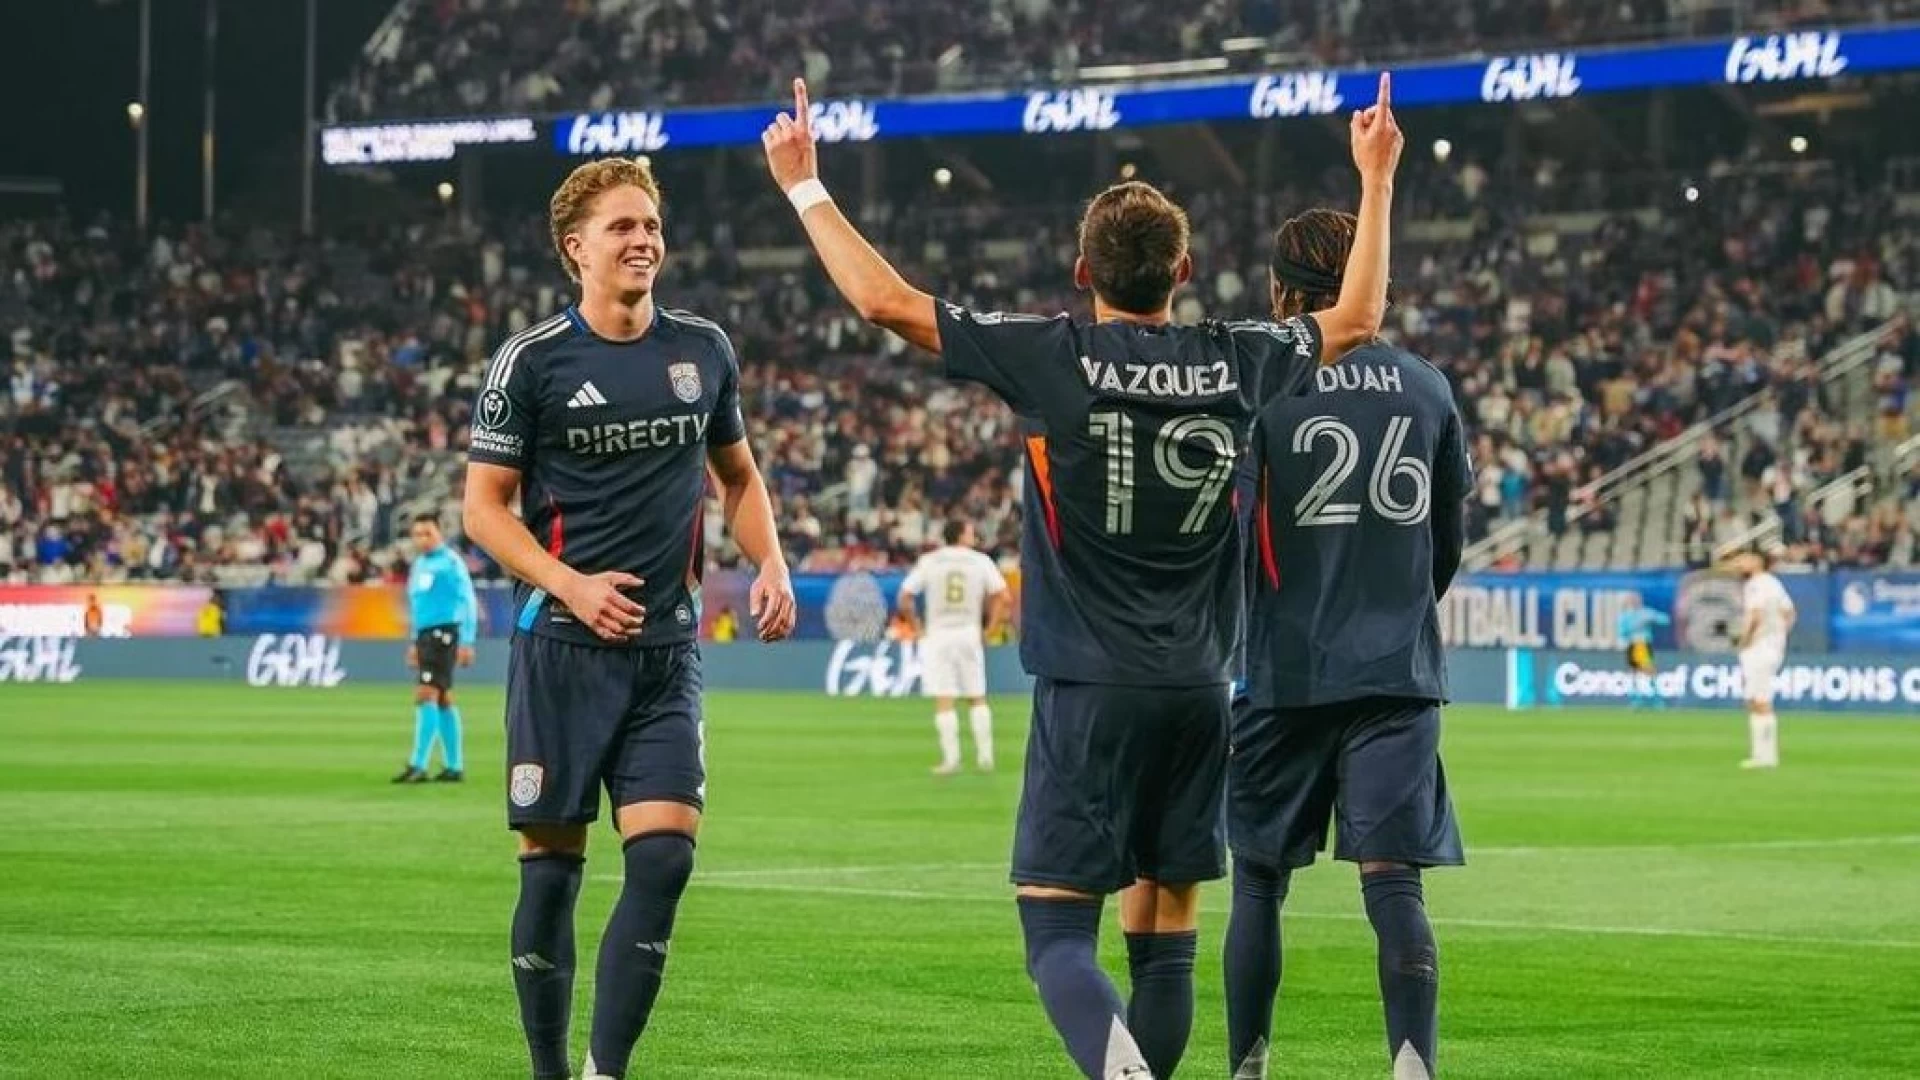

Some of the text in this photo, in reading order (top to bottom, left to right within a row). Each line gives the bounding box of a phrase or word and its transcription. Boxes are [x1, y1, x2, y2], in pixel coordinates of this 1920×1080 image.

[1079, 355, 1238, 397] VAZQUEZ
[1316, 364, 1404, 393] DUAH
[566, 412, 710, 454] DIRECTV
[1088, 411, 1237, 535] 19
[1292, 415, 1431, 526] 26
[945, 570, 965, 605] 6
[1692, 664, 1897, 701] CHMPIONS
